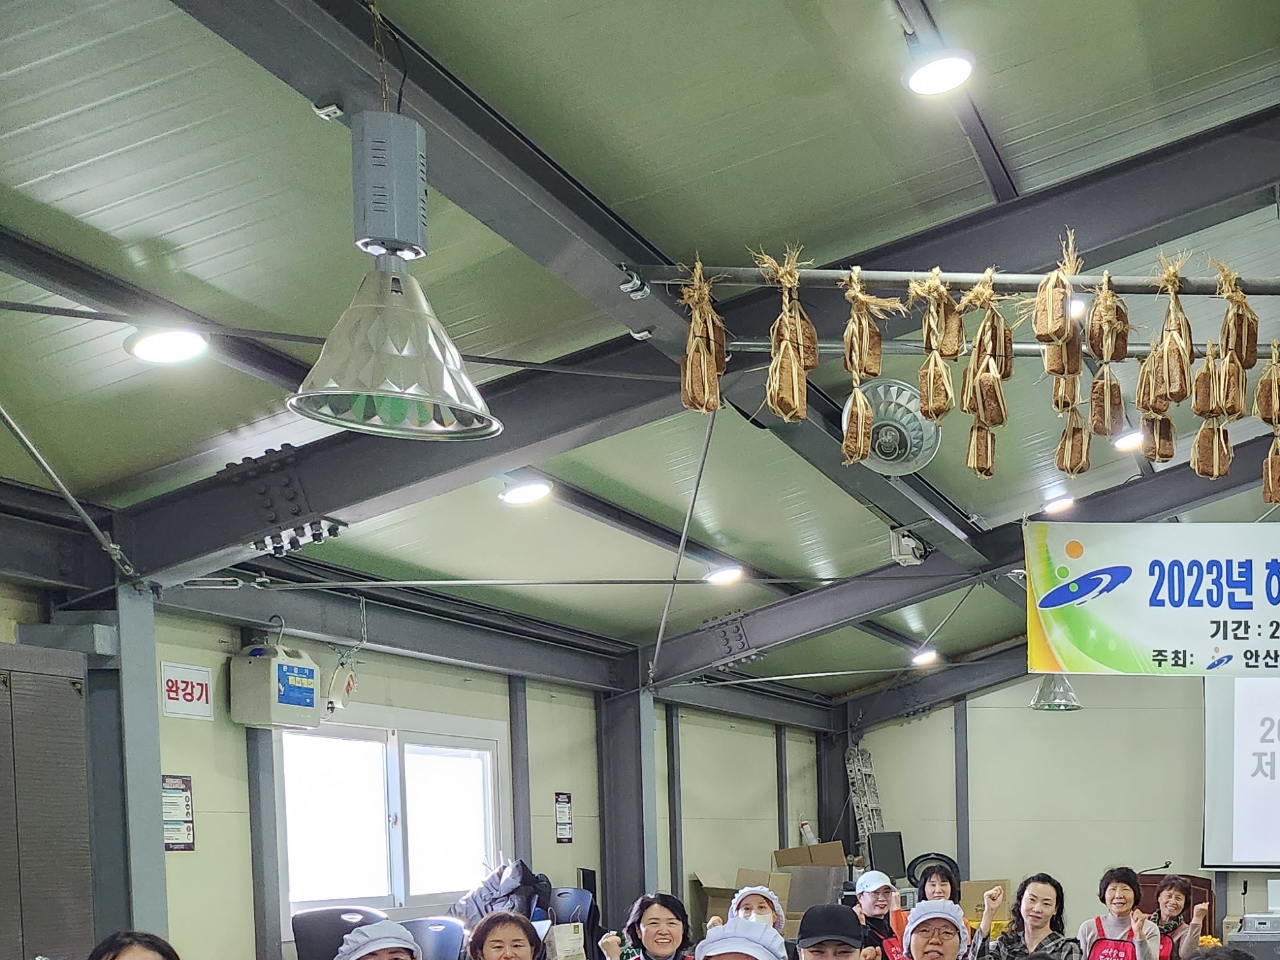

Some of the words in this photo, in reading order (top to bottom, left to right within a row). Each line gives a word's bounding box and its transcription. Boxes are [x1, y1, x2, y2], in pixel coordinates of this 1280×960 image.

[1148, 558, 1254, 611] 2023년
[1209, 619, 1251, 641] 기간
[1151, 649, 1195, 668] 주최:
[164, 677, 210, 705] 완강기
